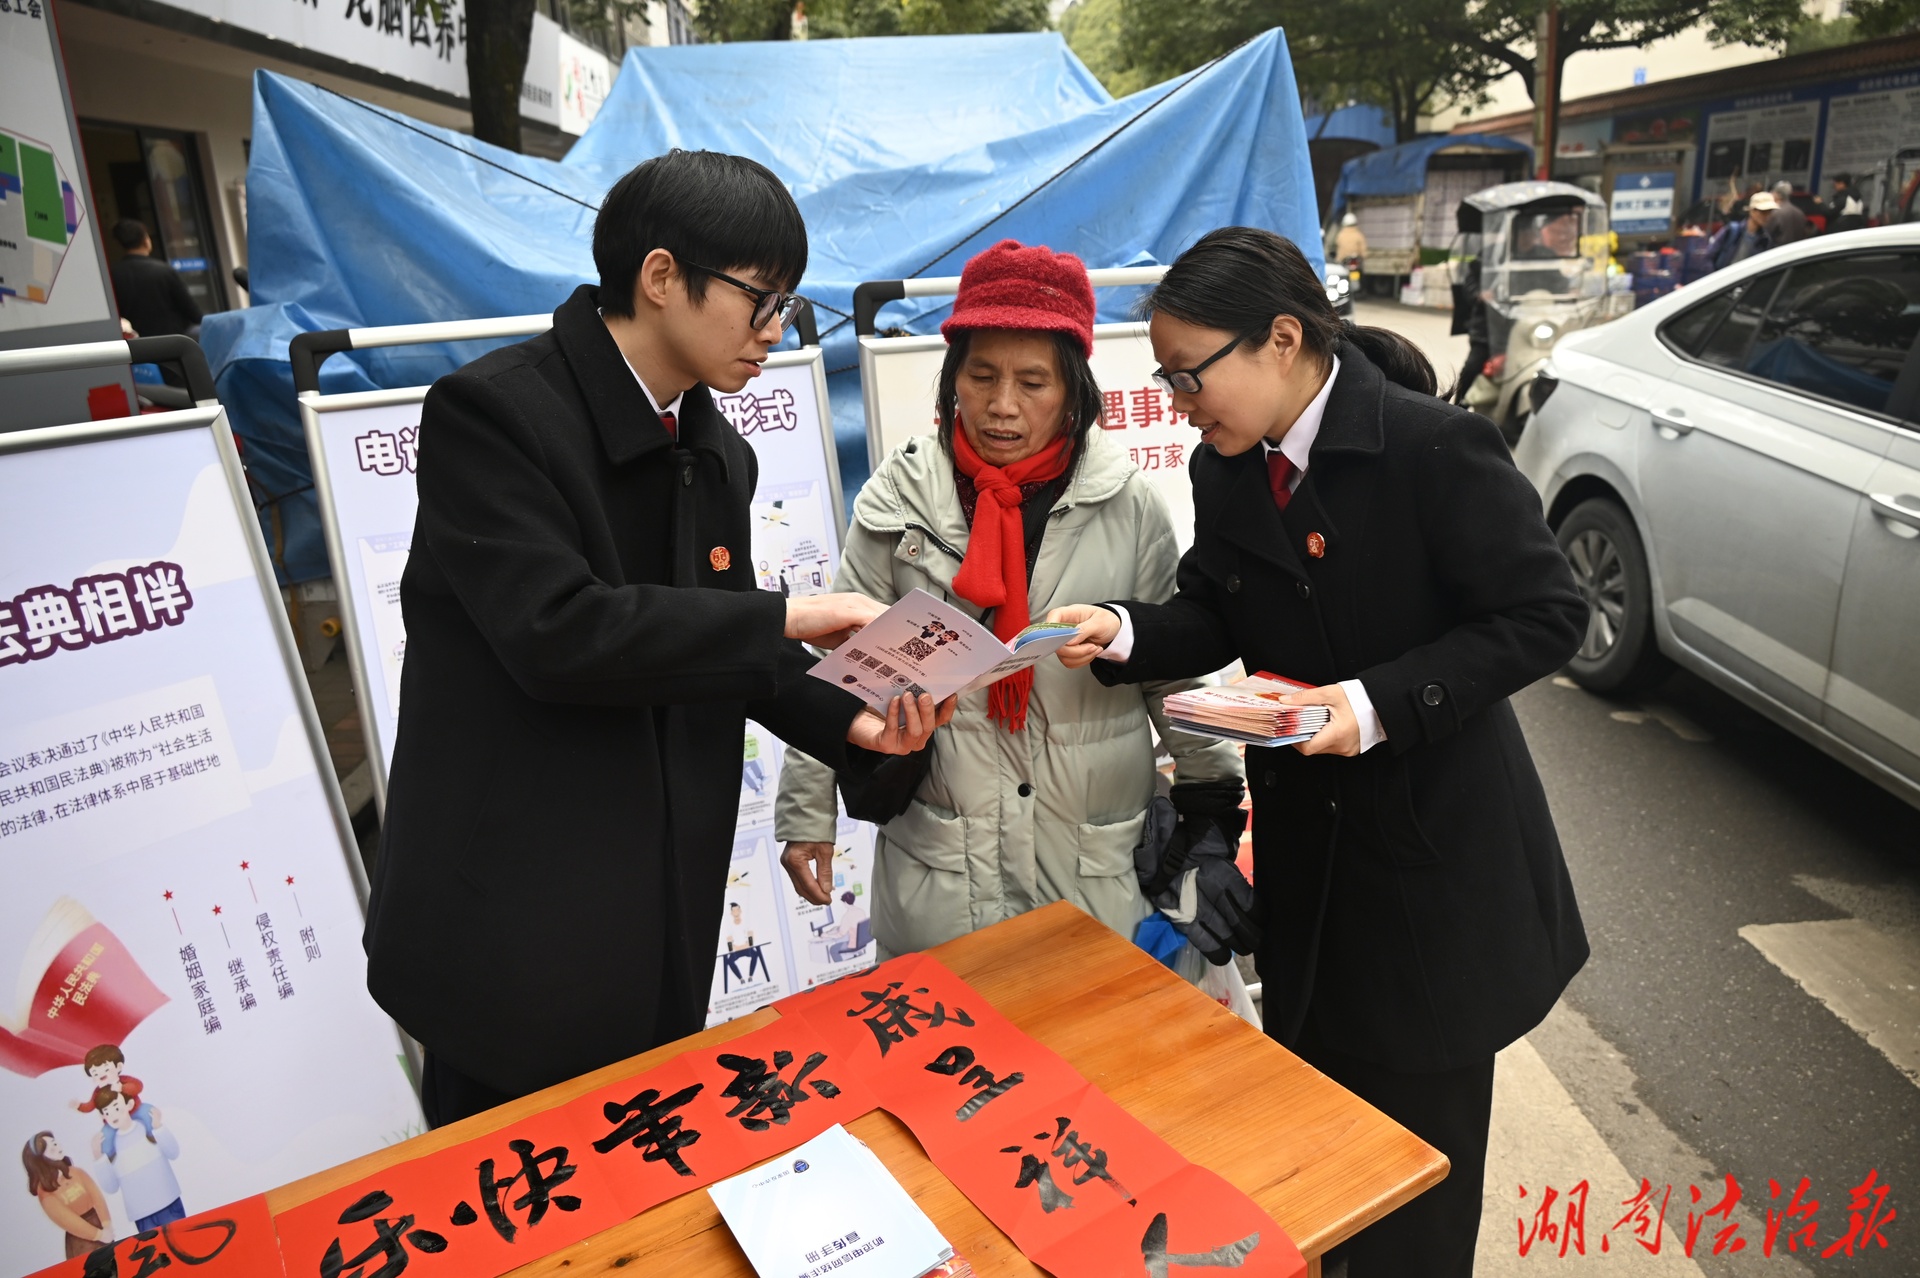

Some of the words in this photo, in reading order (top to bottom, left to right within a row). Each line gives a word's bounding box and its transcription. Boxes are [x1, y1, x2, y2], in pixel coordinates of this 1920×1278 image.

[712, 389, 797, 437] 形式
[0, 753, 221, 839] 的法律，在法律体系中居于基础性地
[255, 912, 295, 1001] 侵权责任编
[299, 925, 322, 963] 附则
[46, 941, 105, 1020] 中华人民共和国
[71, 970, 103, 1007] 民法典
[178, 942, 222, 1036] 婚姻家庭编
[227, 956, 258, 1012] 继承编
[804, 1230, 861, 1264] 宣传手册
